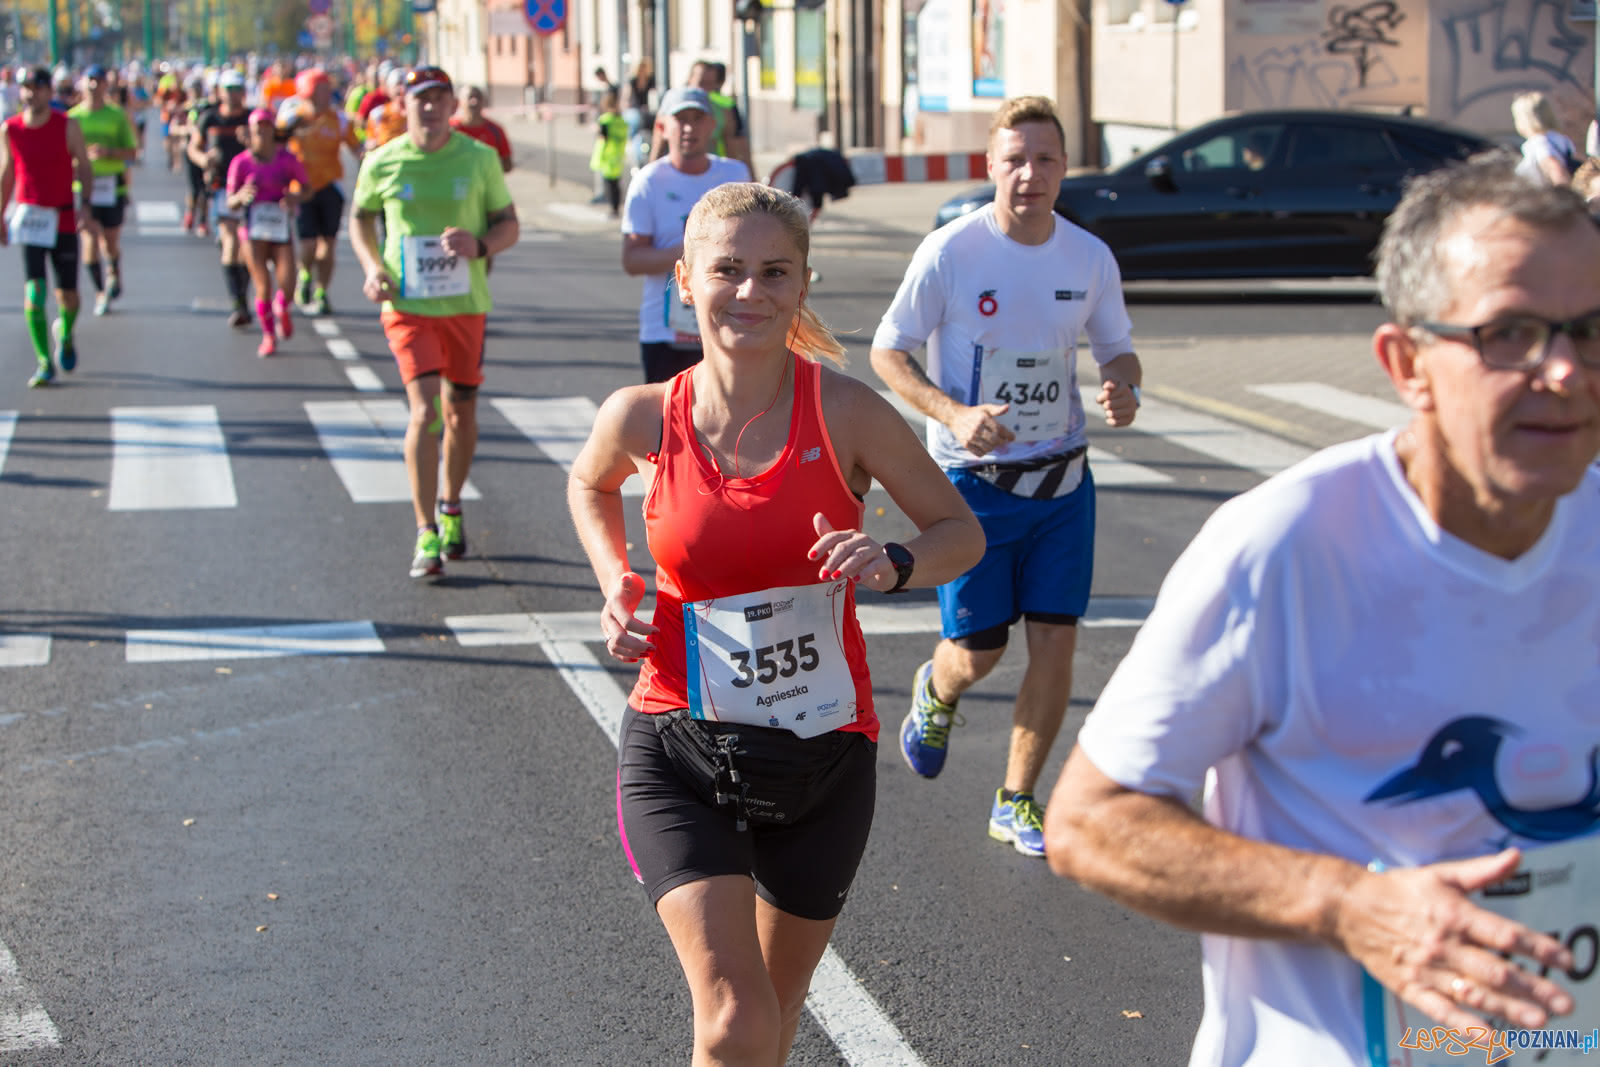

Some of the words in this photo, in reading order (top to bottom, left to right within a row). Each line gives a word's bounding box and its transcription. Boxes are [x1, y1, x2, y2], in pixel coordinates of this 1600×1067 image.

[995, 380, 1060, 405] 4340
[730, 633, 820, 689] 3535
[755, 684, 810, 708] Agnieszka
